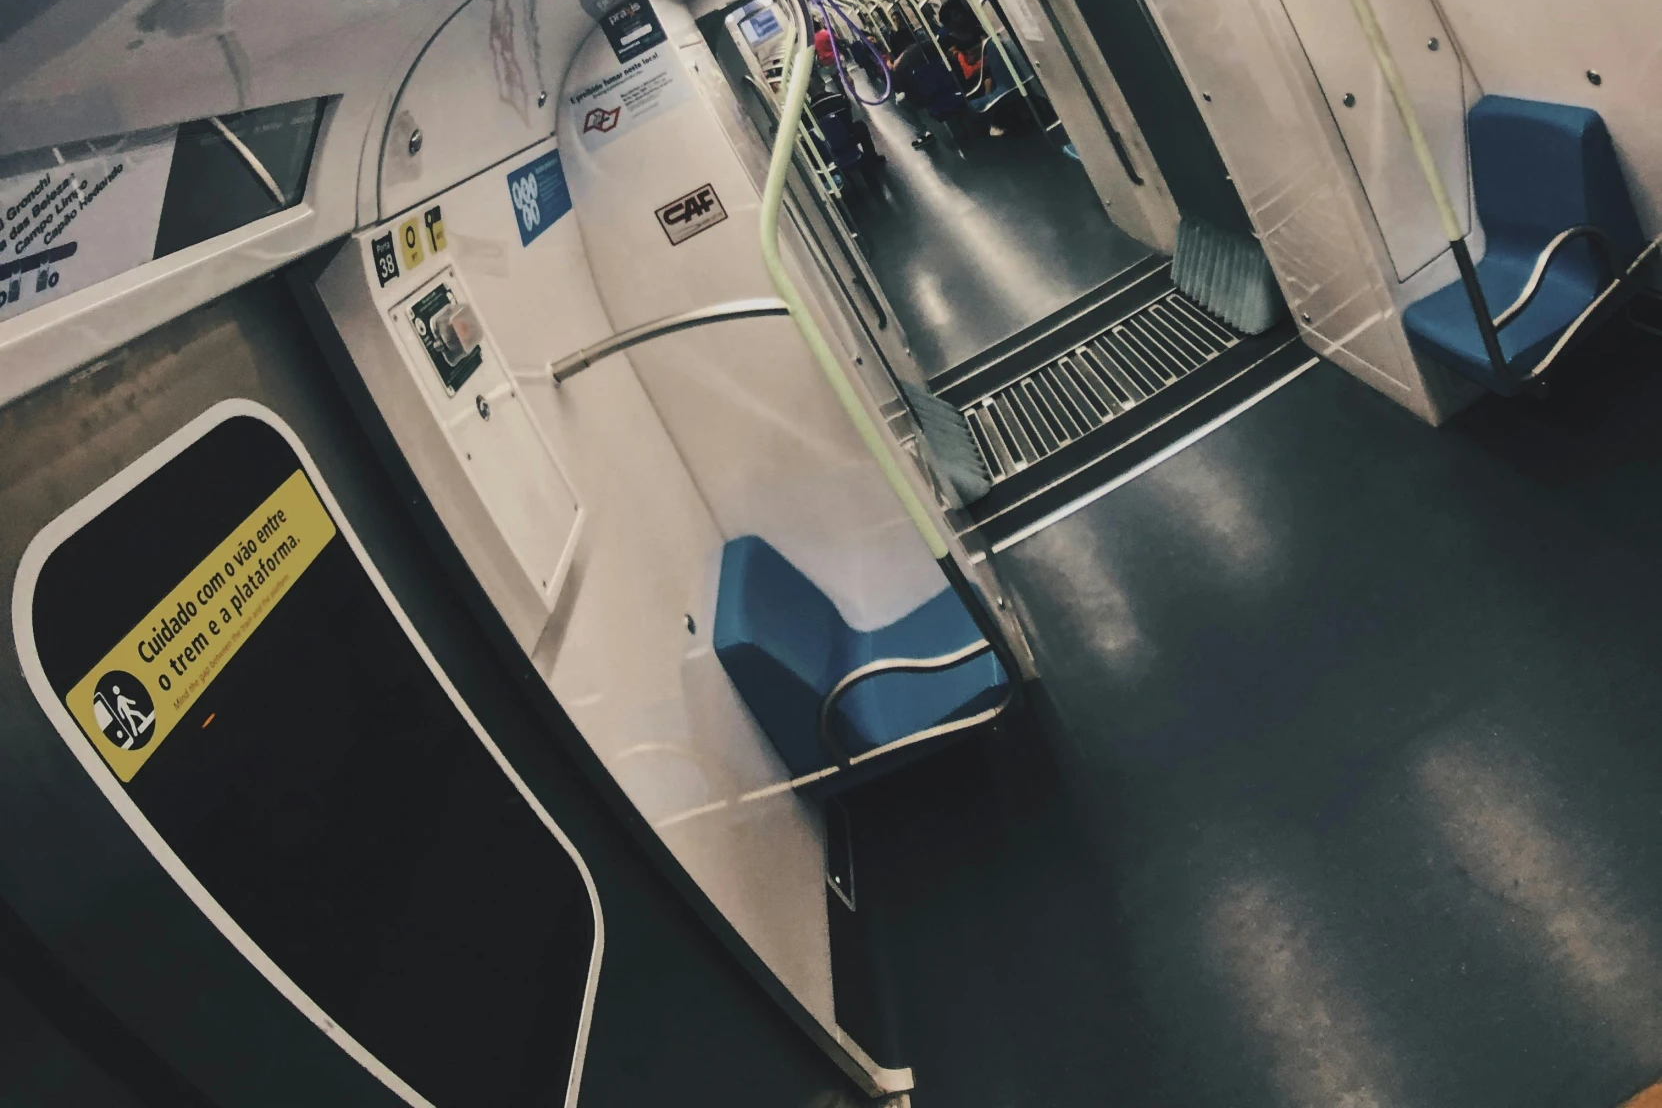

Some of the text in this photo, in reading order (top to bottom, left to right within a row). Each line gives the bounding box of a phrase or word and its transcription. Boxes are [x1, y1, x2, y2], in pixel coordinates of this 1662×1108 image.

[575, 82, 603, 103] proibido
[603, 72, 623, 85] fumar
[643, 52, 659, 66] local
[7, 173, 50, 220] Gronchi
[663, 189, 715, 225] CAF
[10, 217, 30, 240] das
[15, 214, 53, 254] Campo
[44, 209, 77, 245] Capão
[379, 255, 395, 278] 38
[138, 508, 287, 663] Cuidado com o vão entre
[158, 533, 301, 691] o trem e a plataforma.
[173, 689, 190, 711] Mind
[189, 677, 201, 693] the
[199, 666, 212, 686] gap
